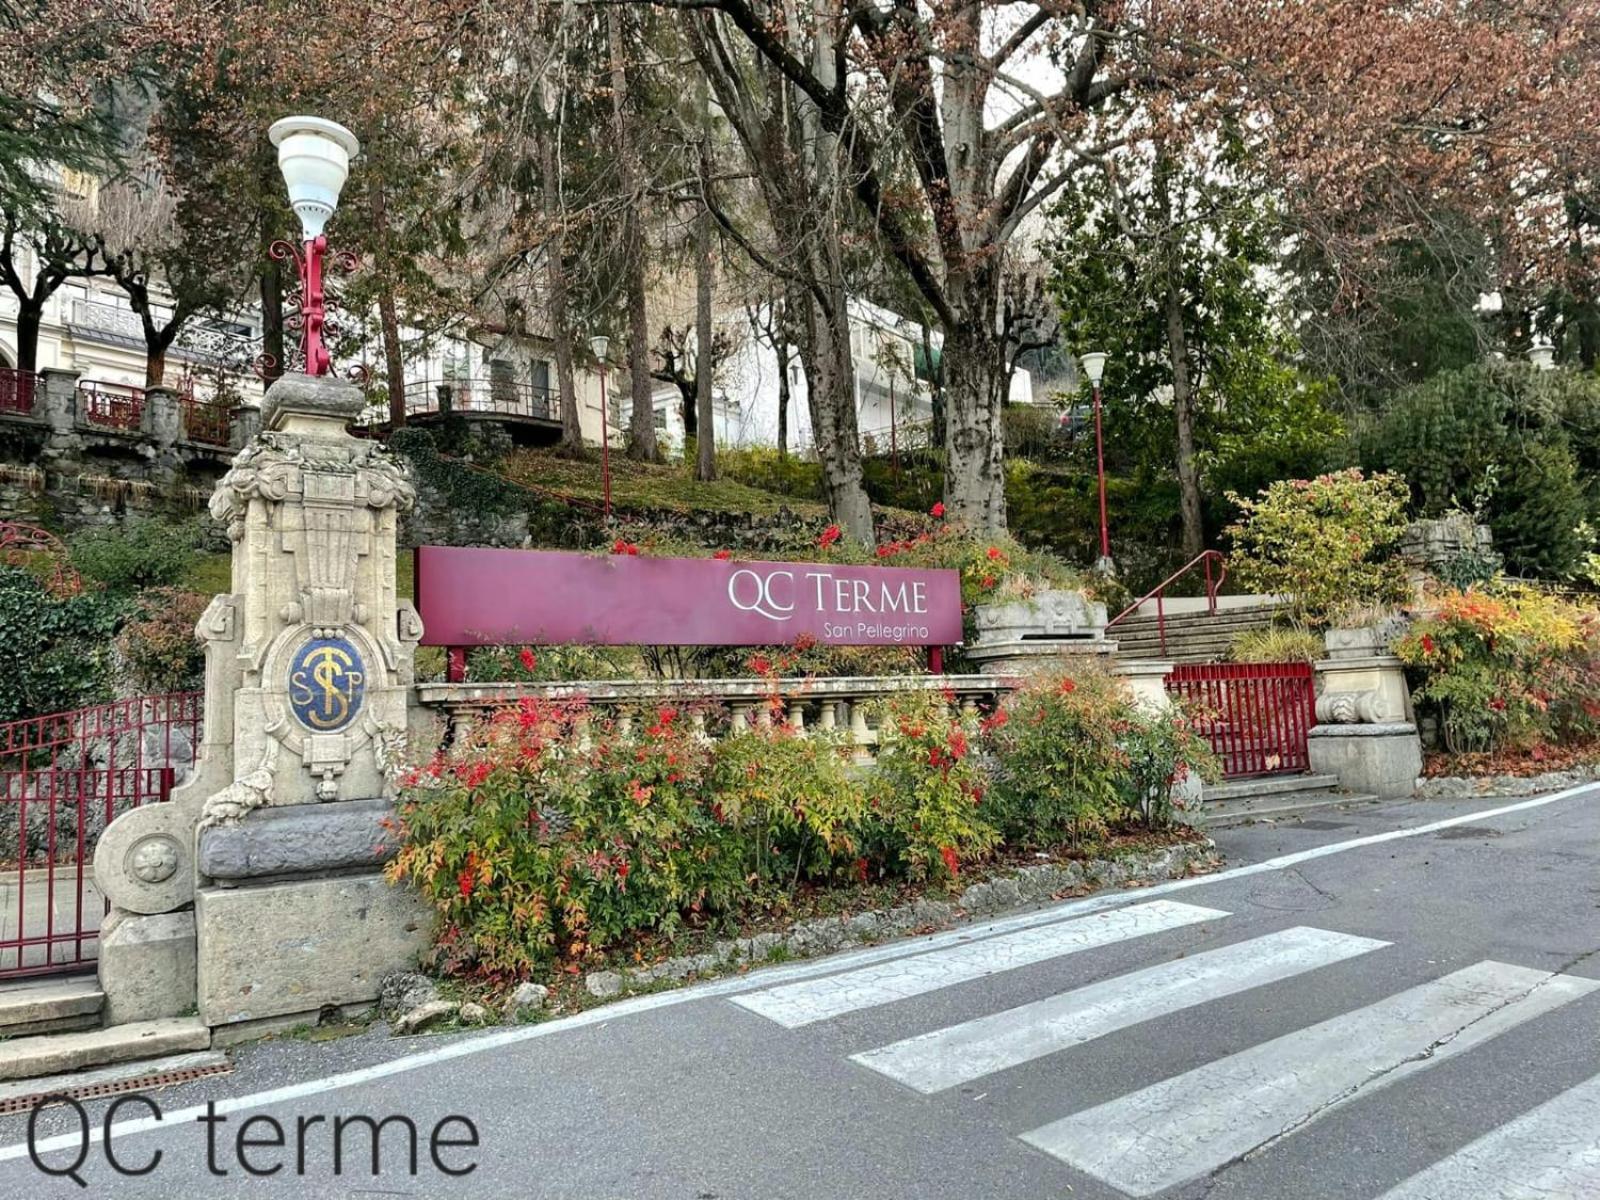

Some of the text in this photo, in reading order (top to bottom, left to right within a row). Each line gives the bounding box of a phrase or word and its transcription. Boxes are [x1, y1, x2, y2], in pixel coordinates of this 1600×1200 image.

[728, 569, 928, 621] QC TERME
[824, 622, 929, 641] San Pellegrino
